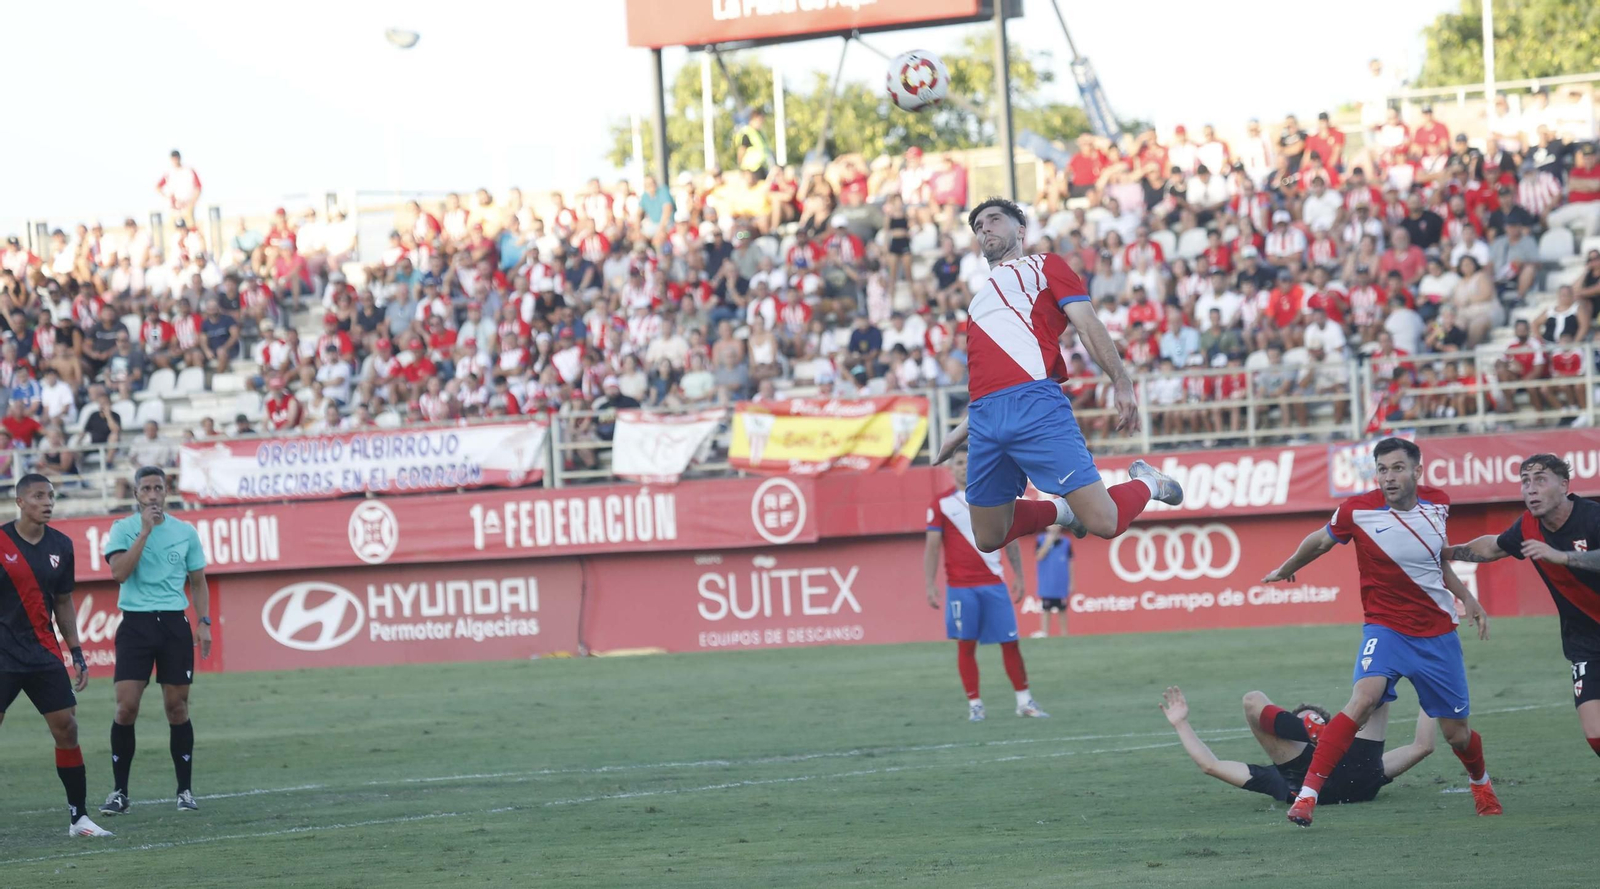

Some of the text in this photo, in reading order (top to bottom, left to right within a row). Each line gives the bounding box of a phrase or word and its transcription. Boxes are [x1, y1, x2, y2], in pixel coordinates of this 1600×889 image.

[257, 433, 460, 468] ORGULLO ALBIRROJO
[237, 454, 483, 498] ALGECIRAS EN EL CORAZÓN
[1100, 450, 1295, 513] hostel
[1427, 452, 1523, 487] CLÍNIC
[504, 488, 677, 548] FEDERACIÓN
[197, 509, 280, 565] ACIÓN
[367, 576, 540, 619] HYUNDAI
[1070, 593, 1138, 613] Center
[1141, 590, 1215, 613] Campo
[1217, 587, 1245, 607] de
[1247, 584, 1340, 605] Gibraltar
[369, 614, 540, 642] Permotor Algeciras
[699, 625, 864, 647] EQUIPOS DE DESCANSO
[1363, 637, 1378, 656] 8
